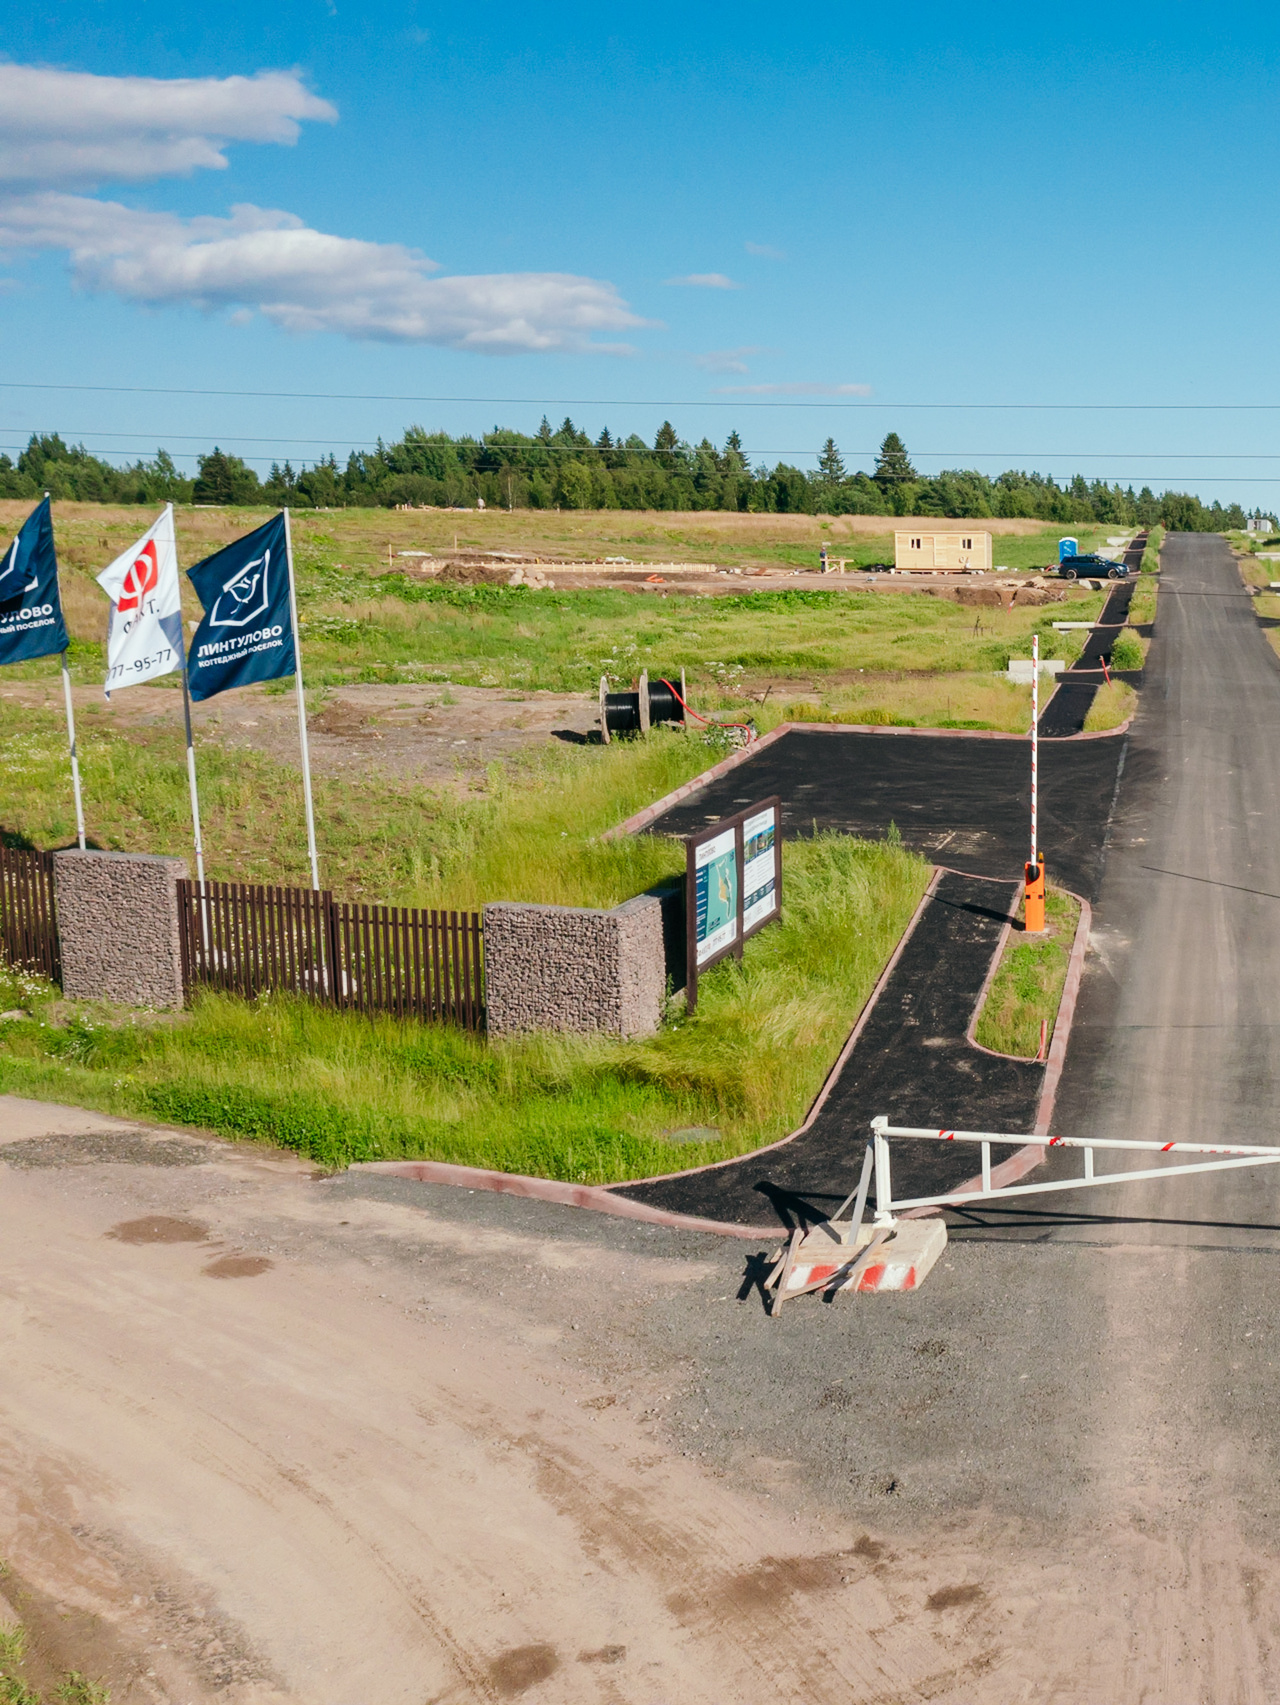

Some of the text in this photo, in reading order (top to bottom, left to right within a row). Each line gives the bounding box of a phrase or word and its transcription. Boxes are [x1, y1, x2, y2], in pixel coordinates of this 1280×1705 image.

[16, 617, 56, 631] ПОСЕЛОК
[197, 624, 283, 658] ЛИНТУЛОВО
[197, 639, 284, 668] КОТТЕДЖНЫЙ ПОСЕЛОК
